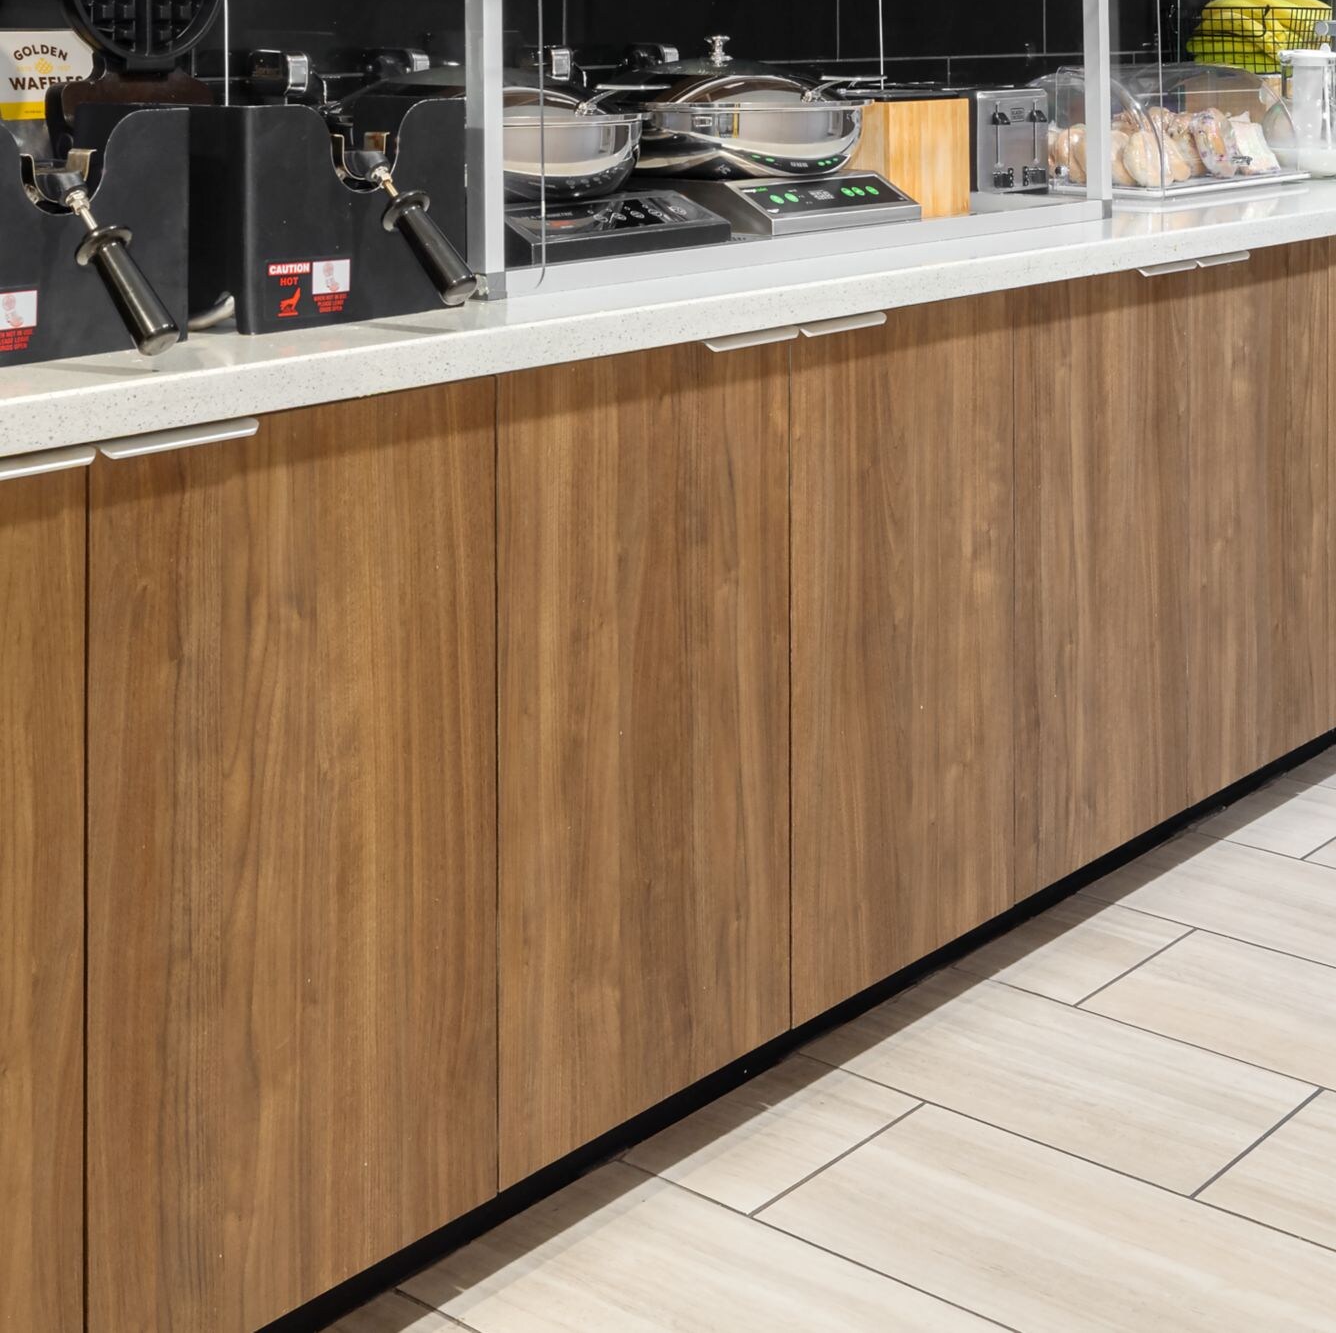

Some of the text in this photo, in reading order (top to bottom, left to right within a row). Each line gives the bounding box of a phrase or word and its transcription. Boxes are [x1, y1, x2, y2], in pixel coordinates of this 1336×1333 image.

[13, 44, 68, 61] GOLDEN
[269, 263, 310, 275] CAUTION
[280, 277, 299, 286] HOT
